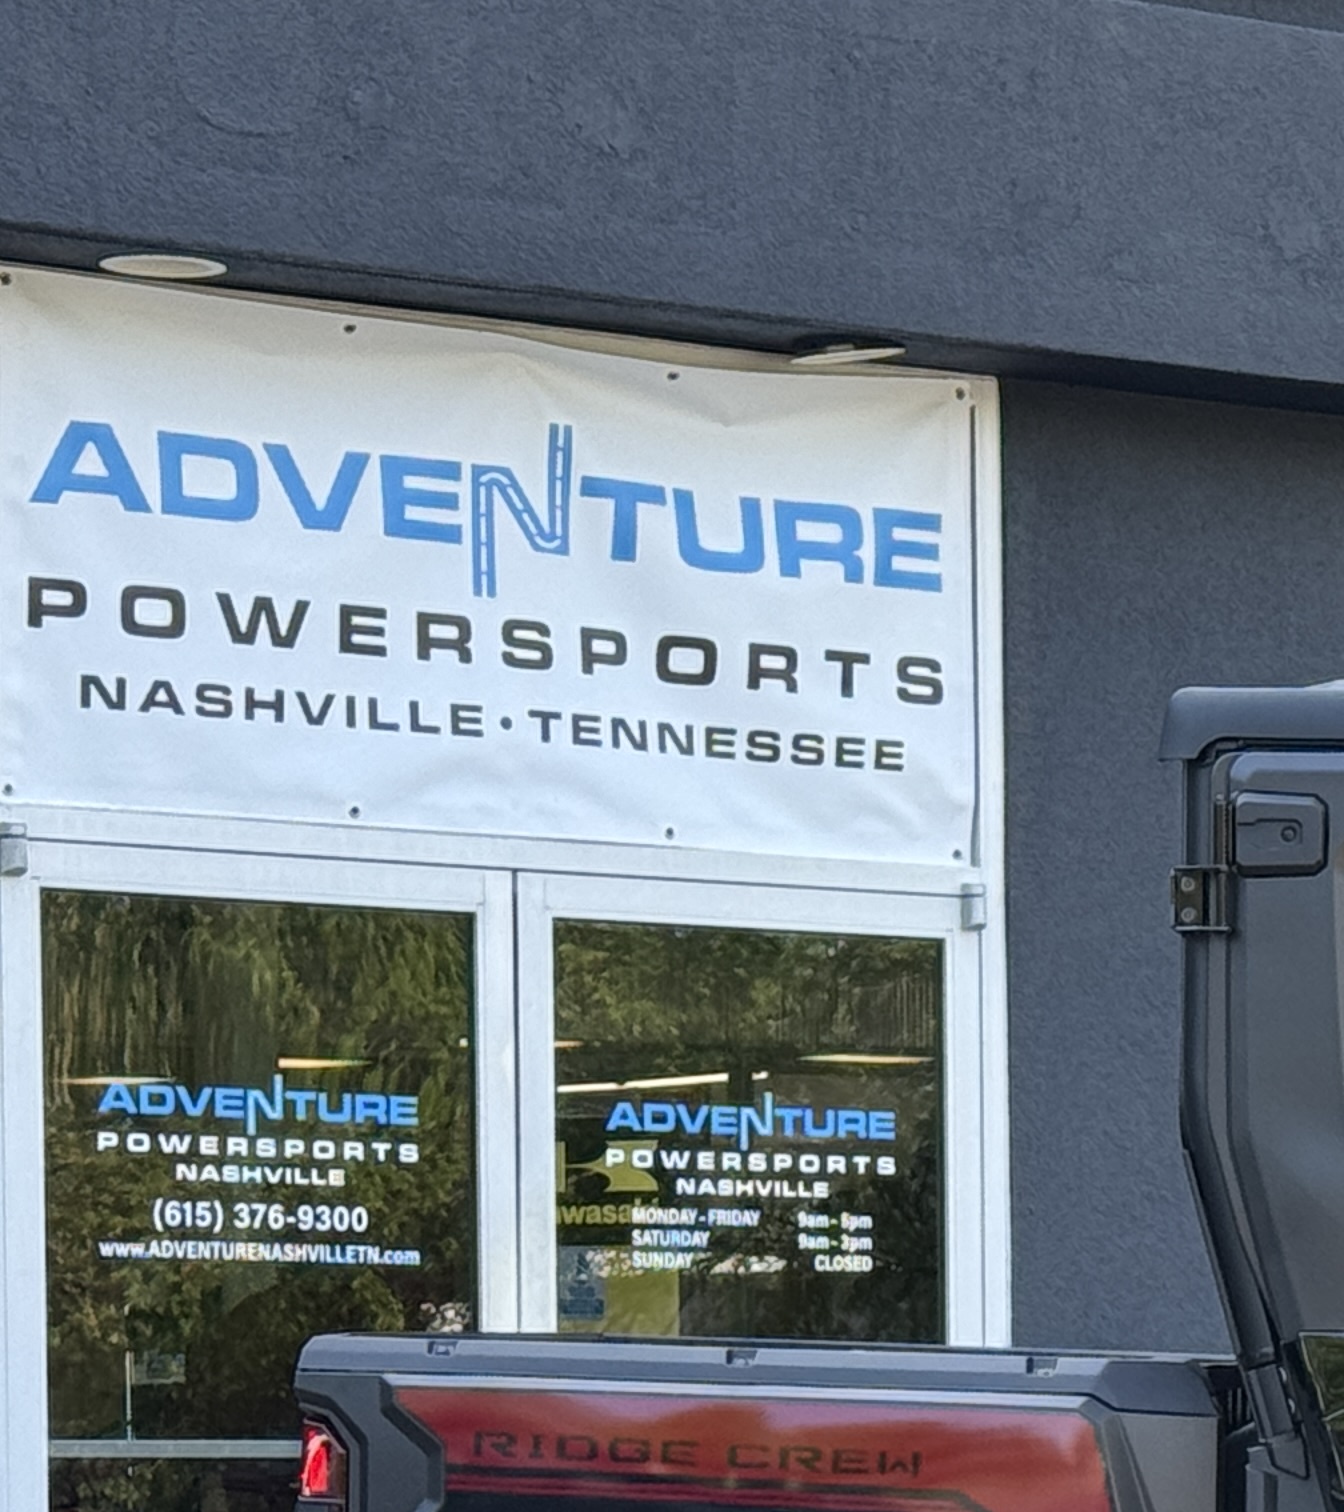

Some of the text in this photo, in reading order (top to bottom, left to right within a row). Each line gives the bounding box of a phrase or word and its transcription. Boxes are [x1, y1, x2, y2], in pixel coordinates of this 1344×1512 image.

[29, 420, 944, 597] ADVENTURE
[25, 575, 945, 708] POWERSPORTS
[78, 674, 906, 773] NASHVILLE TENNESSEE
[98, 1074, 419, 1136] ADVENTURE
[605, 1091, 896, 1150] ADVENTURE
[96, 1131, 420, 1163] POWERSPORTS
[605, 1148, 897, 1175] POWERSPORTS
[175, 1163, 346, 1187] NASHVILLE
[675, 1177, 830, 1199] NASHVILLE
[153, 1197, 369, 1233] (615) 376-9300
[631, 1207, 698, 1226] MONDAY
[707, 1208, 761, 1227] FRIDAY
[98, 1240, 421, 1265] www.ADVENTURENASHVILLETN.com
[631, 1229, 711, 1248] SATURDAY
[631, 1250, 873, 1272] SUNDAY CLOSED
[472, 1429, 923, 1479] RIDGE CREW
